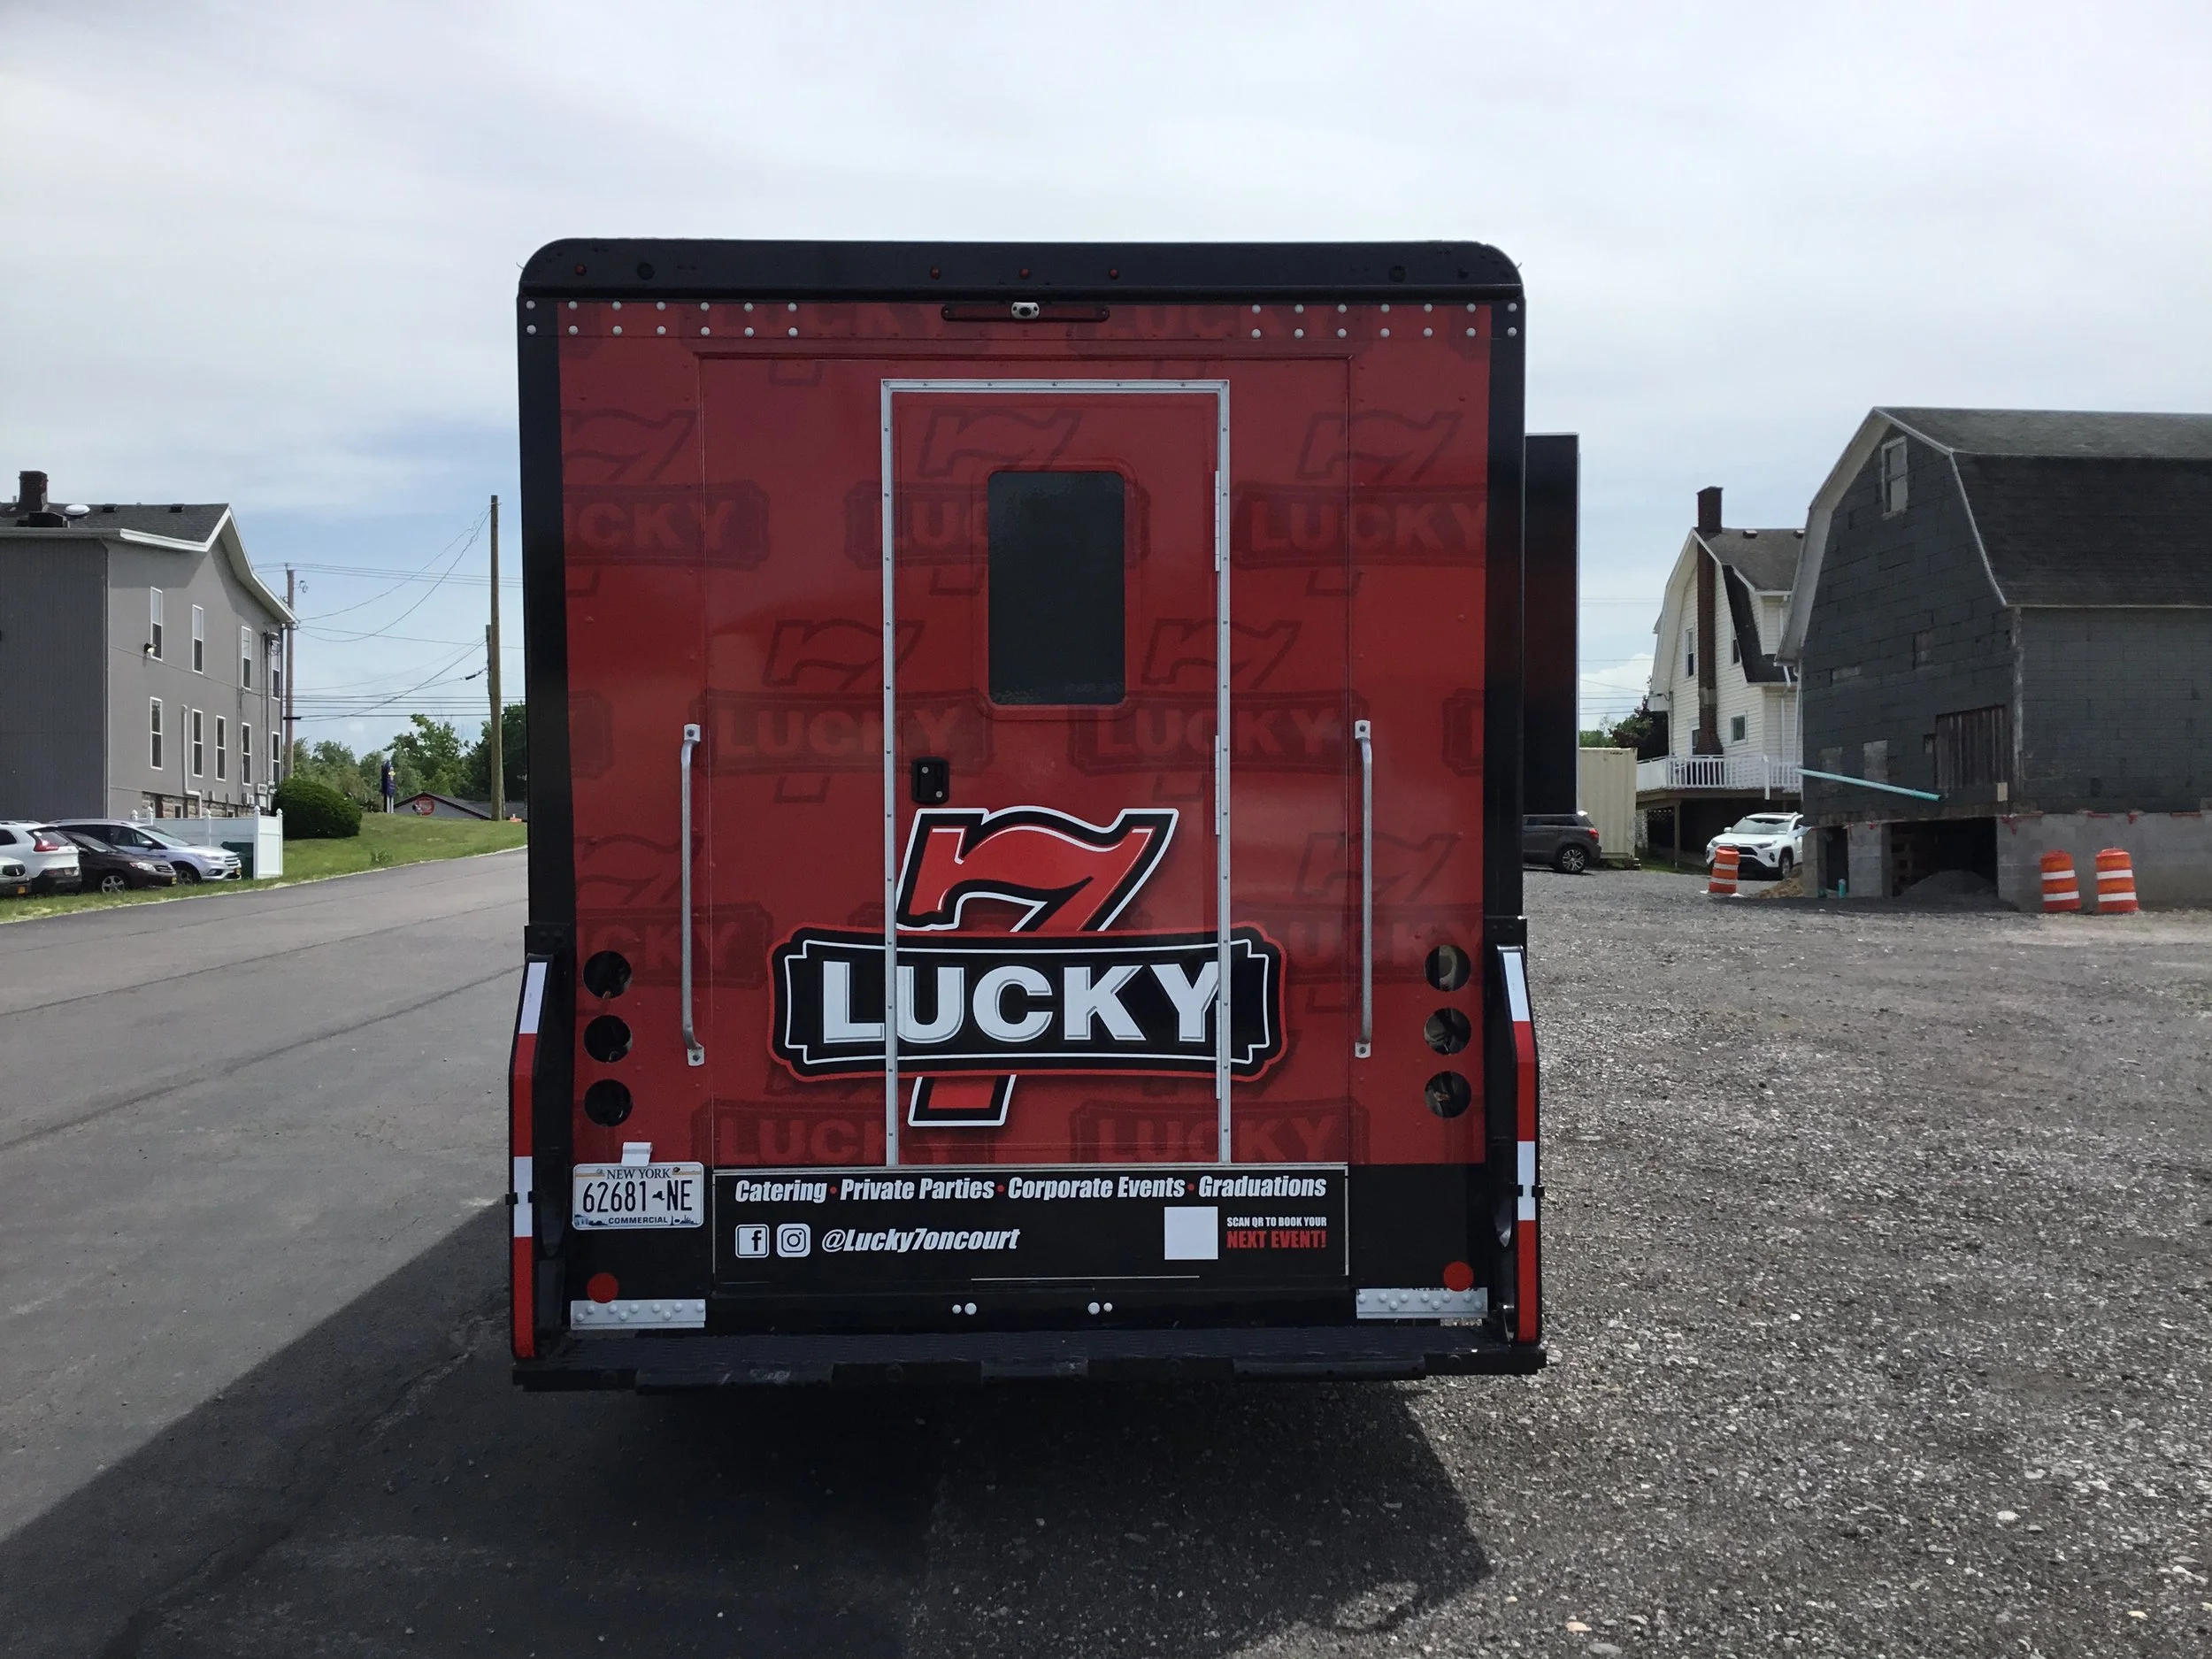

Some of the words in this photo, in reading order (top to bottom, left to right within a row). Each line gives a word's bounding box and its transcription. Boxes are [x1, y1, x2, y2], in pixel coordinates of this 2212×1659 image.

[823, 961, 1220, 1043] LUCKY
[607, 1169, 634, 1179] NEW
[638, 1168, 672, 1179] YORK
[583, 1180, 646, 1212] 62681
[667, 1179, 693, 1211] NE
[735, 1179, 827, 1203] Catering
[840, 1179, 915, 1201] Private
[918, 1178, 995, 1200] Parties
[1008, 1177, 1113, 1201] Corporate
[1118, 1176, 1186, 1198] Events
[1198, 1175, 1327, 1197] Graduations
[1226, 1217, 1250, 1227] SCAN
[1252, 1217, 1263, 1227] QR
[1265, 1217, 1277, 1227] TO
[1279, 1217, 1302, 1227] BOOK
[1303, 1217, 1327, 1227] YOUR
[821, 1227, 1021, 1253] @Lucky7oncourt
[1226, 1230, 1267, 1249] NEXT
[1271, 1230, 1327, 1249] EVENT!
